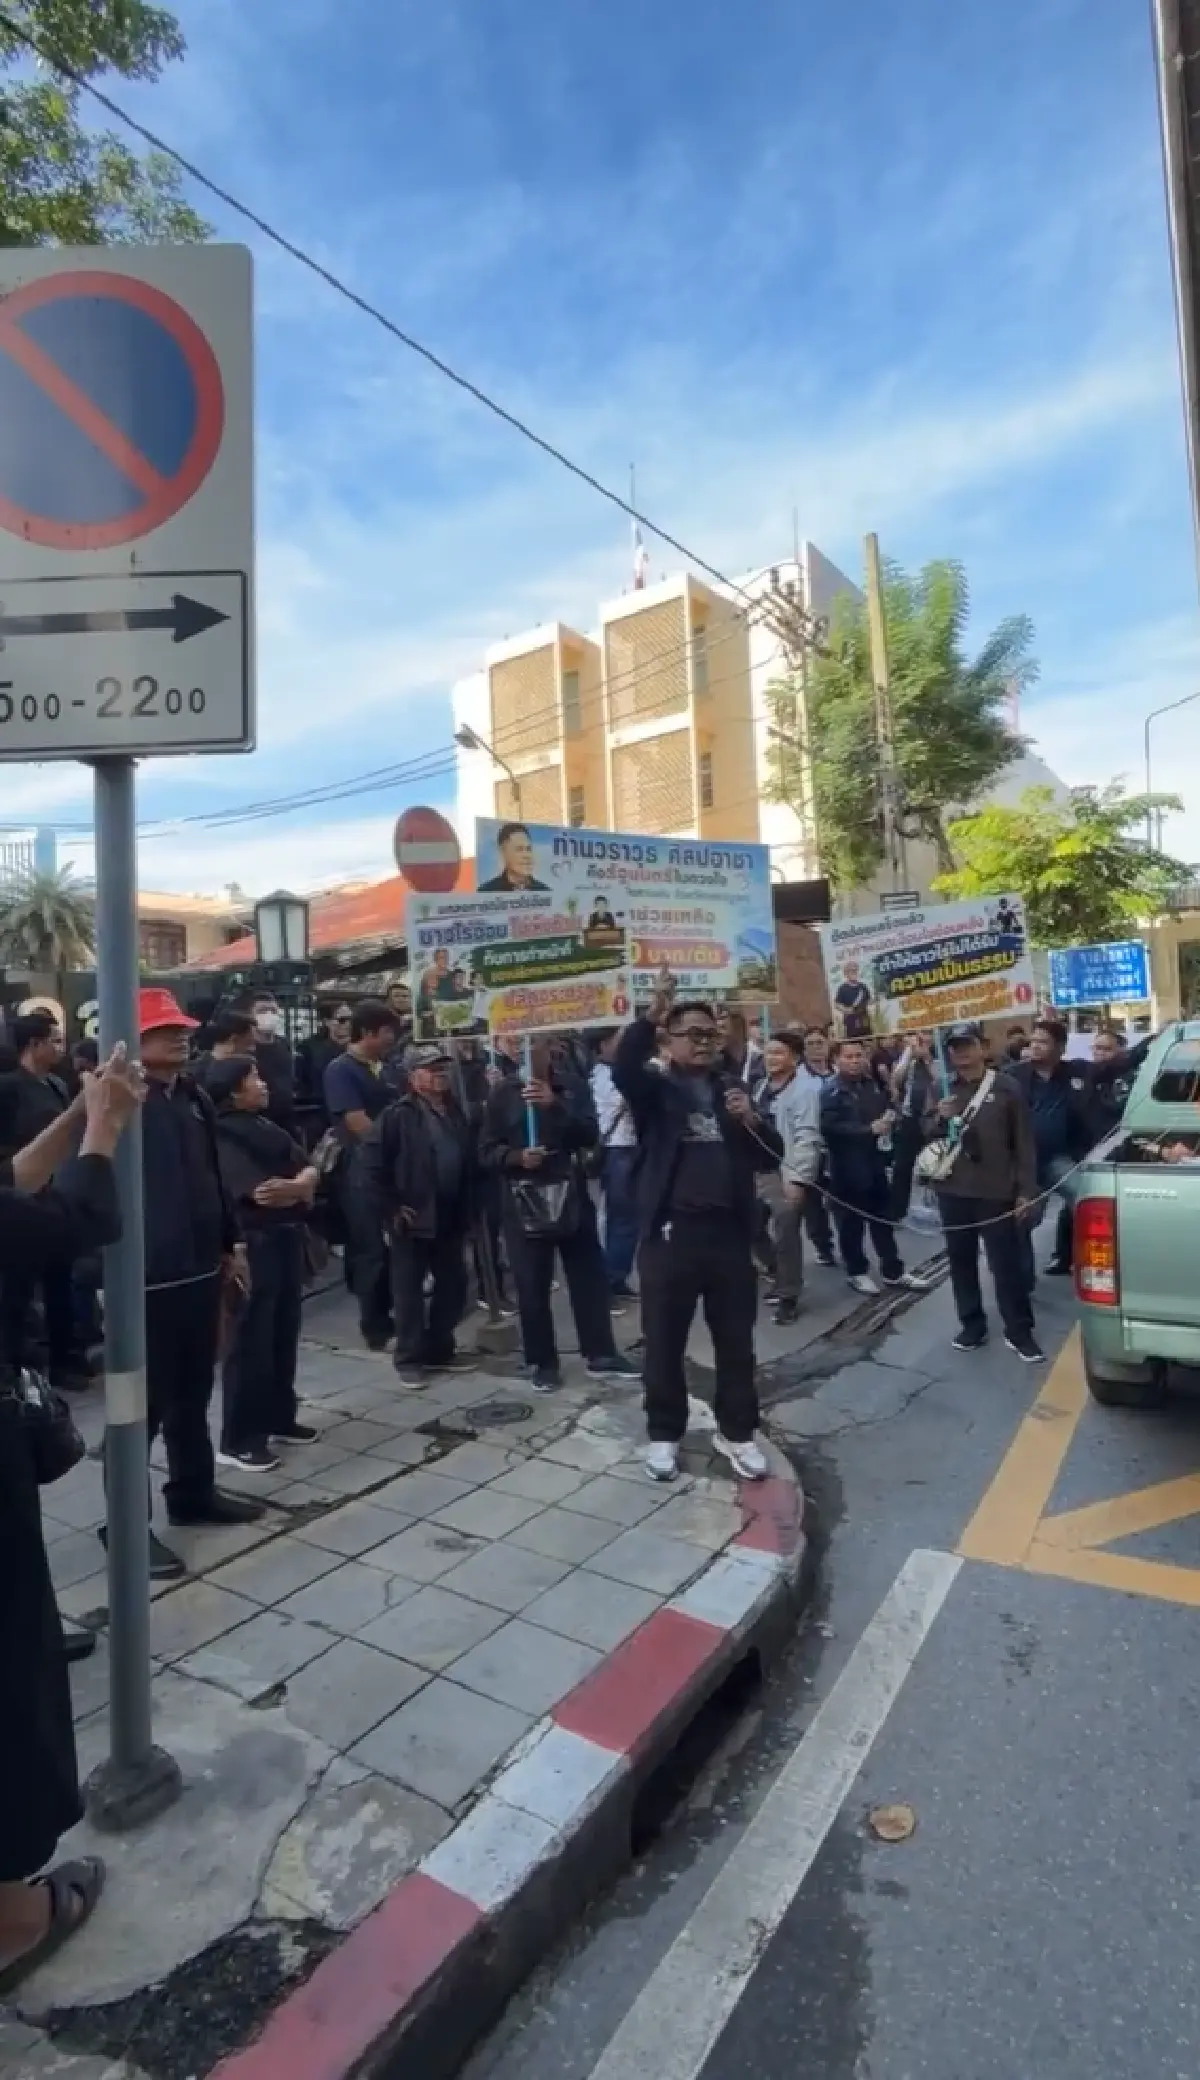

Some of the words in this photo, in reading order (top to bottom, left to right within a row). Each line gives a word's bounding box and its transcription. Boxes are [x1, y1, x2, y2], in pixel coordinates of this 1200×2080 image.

[553, 832, 658, 867] ท่านวราวุธ
[668, 843, 754, 870] ศิลปอาชา
[890, 950, 1016, 993] ความเป็นธรรม
